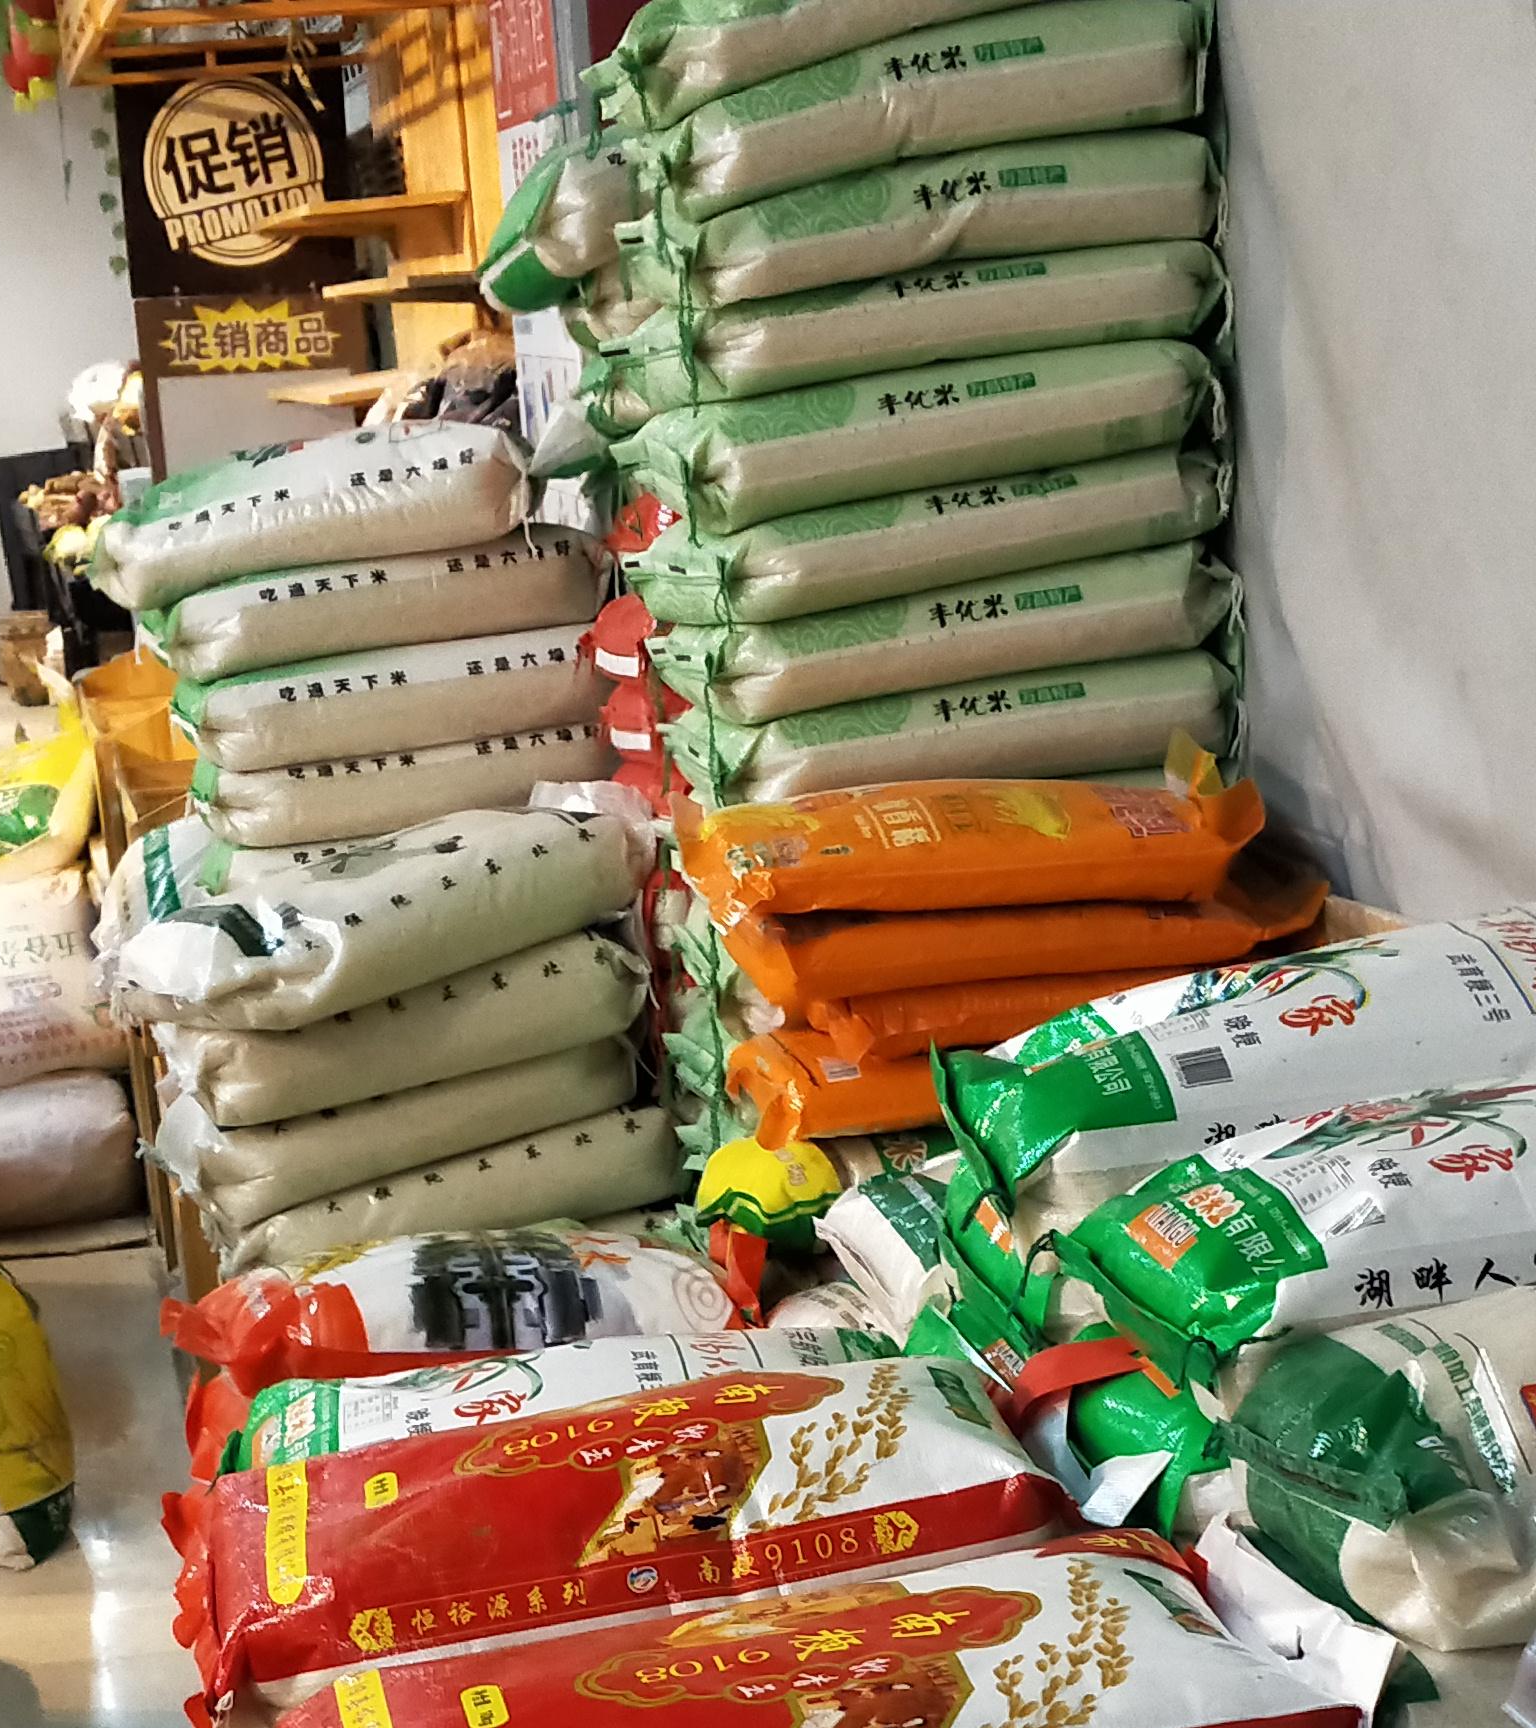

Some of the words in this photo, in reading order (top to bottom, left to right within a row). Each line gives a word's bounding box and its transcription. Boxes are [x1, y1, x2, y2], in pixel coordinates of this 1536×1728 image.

[161, 112, 300, 204] 促销
[170, 318, 333, 364] 促销商品
[410, 1578, 590, 1636] 恒裕源系列
